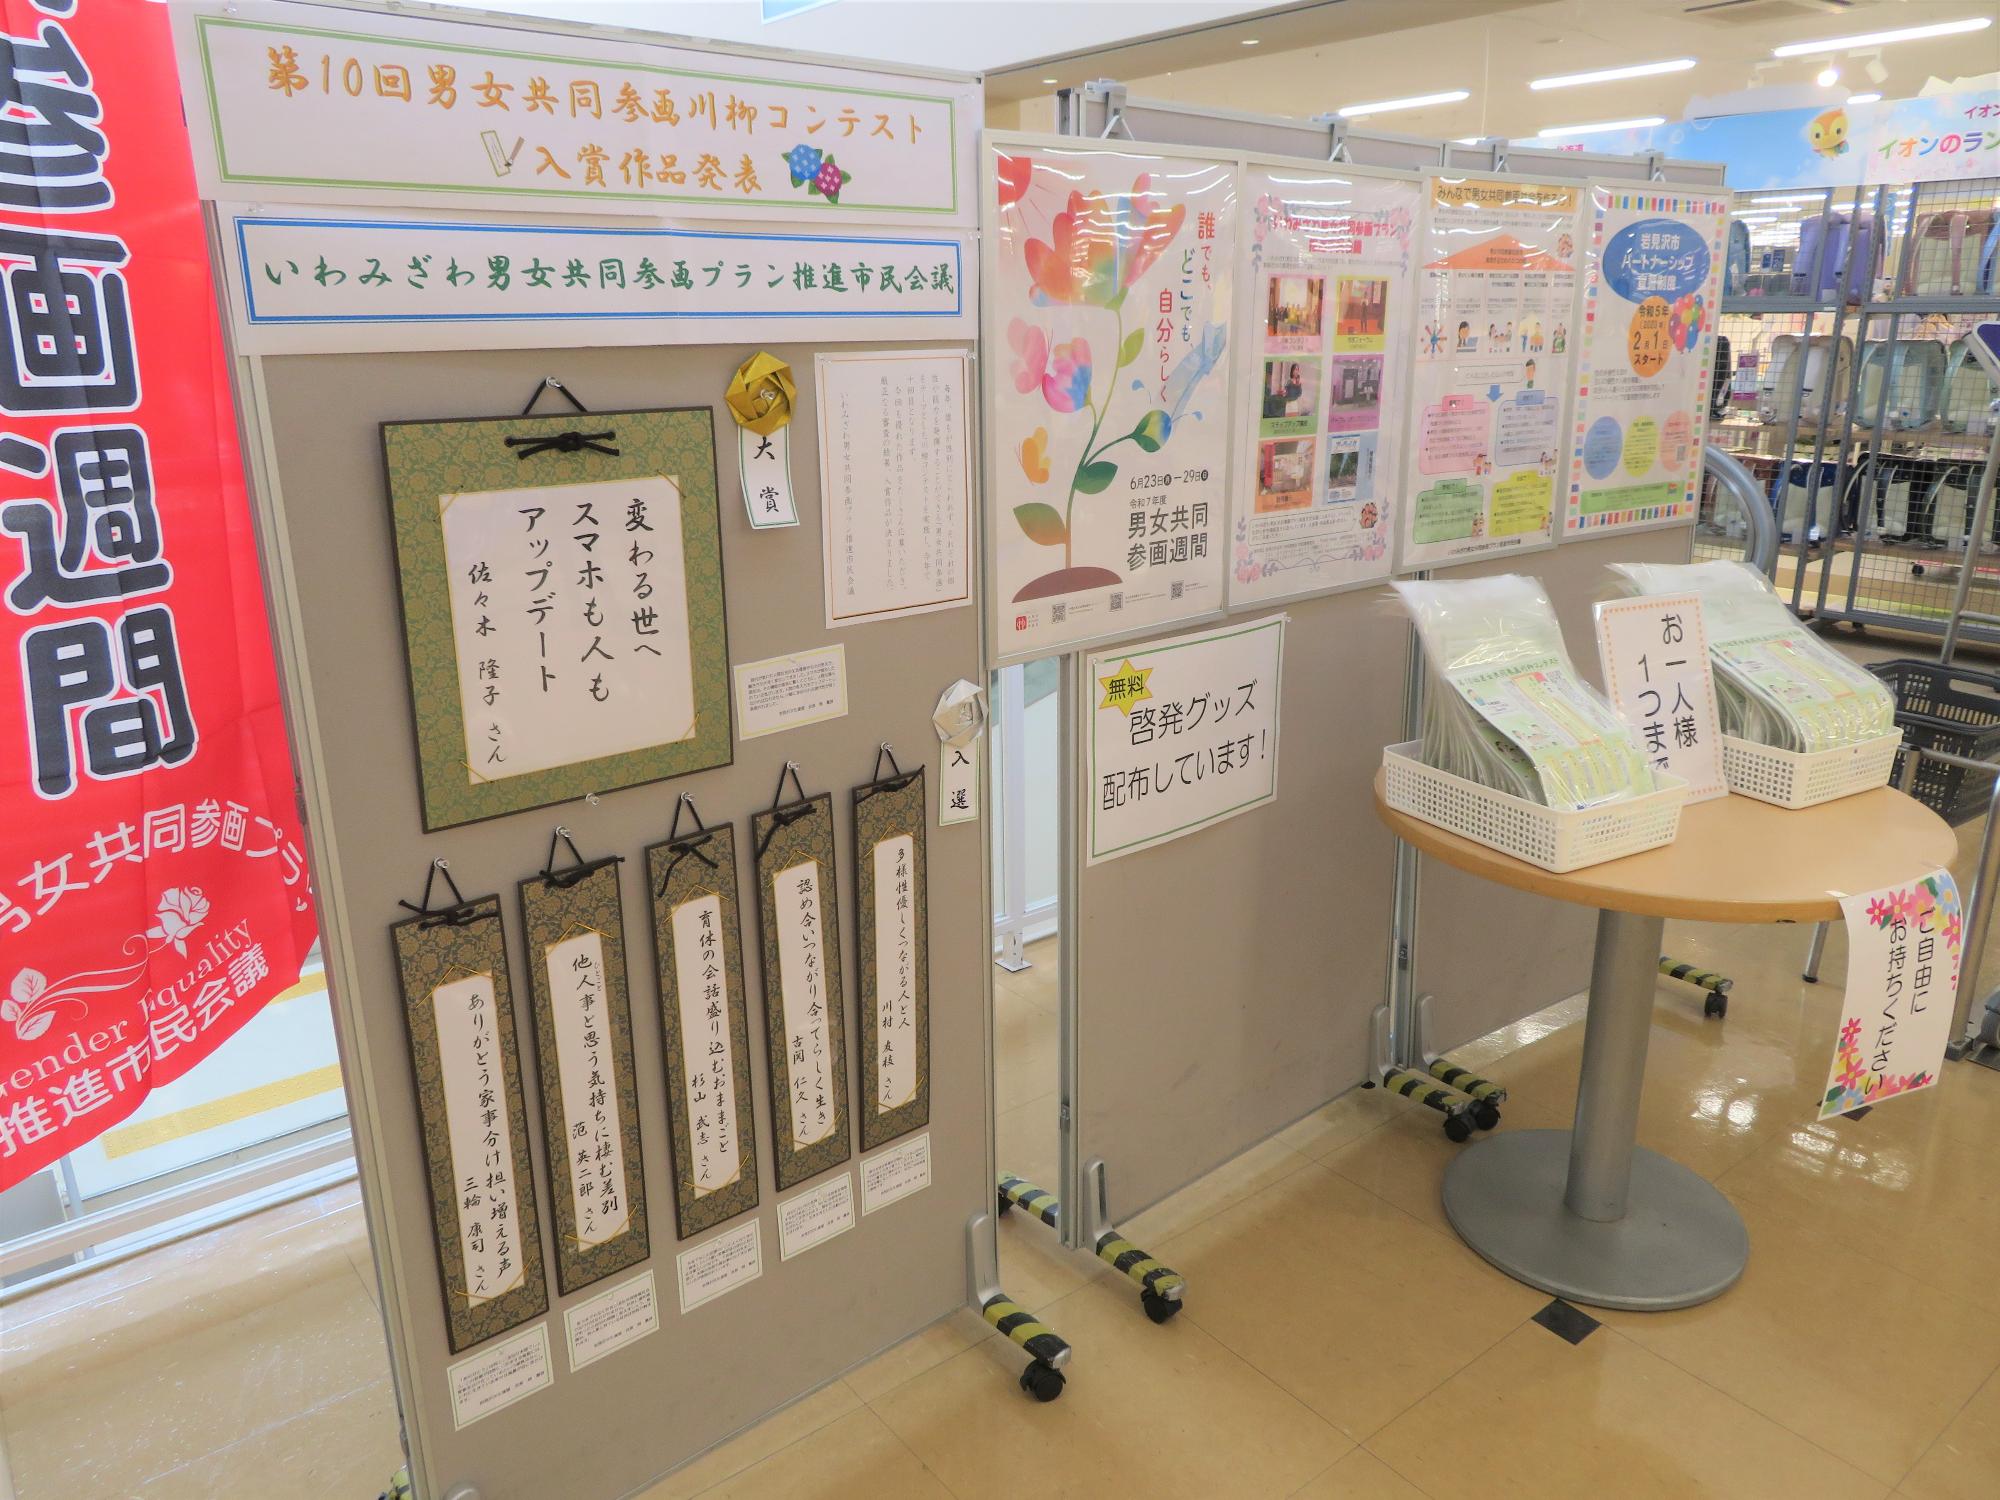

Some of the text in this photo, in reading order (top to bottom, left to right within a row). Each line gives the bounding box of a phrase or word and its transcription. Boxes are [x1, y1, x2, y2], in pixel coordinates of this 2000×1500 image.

[265, 44, 925, 144] 第10回男女共同参画川柳コンテスト
[535, 143, 763, 196] 入賞作品発表
[263, 252, 957, 296] いわみざわ男女共同参画プラン推進市民会議
[1198, 211, 1216, 290] 誰でも、
[1640, 233, 1681, 250] 岩見沢市
[1156, 288, 1174, 402] 自分らしく
[1180, 248, 1196, 348] どこでも、
[0, 0, 198, 800] 参画週間
[1634, 353, 1663, 366] スタート
[753, 435, 780, 513] 大賞
[1128, 501, 1209, 540] 男女共同
[1129, 494, 1168, 509] 令和7年度
[518, 506, 558, 693] アップデート
[572, 502, 615, 702] スマホも人も
[625, 497, 662, 658] 変わる世へ
[1126, 532, 1208, 572] 参画週間
[468, 561, 505, 765] 佐々木 隆子 さん
[1108, 674, 1144, 702] 無料
[1130, 678, 1258, 746] 啓発グッズ
[1661, 614, 1698, 749] お一人様
[949, 750, 970, 811] 入選
[0, 797, 312, 933] 女共同参画プラ
[895, 847, 911, 1030] 多様性優しくつながる人と人
[1910, 904, 1936, 1016] ご自由に
[0, 943, 270, 1158] 推進市民会議
[698, 909, 729, 1153] 育休の会話盛り込むおままごと
[882, 1000, 893, 1029] 川村
[1864, 917, 1908, 1096] お持ちください
[0, 1019, 128, 1098] ender
[572, 953, 619, 1215] 他人事と思う気持ちに棲む差別
[692, 1073, 706, 1102] 杉山
[467, 992, 512, 1279] ありがとう家事分け担い増える声
